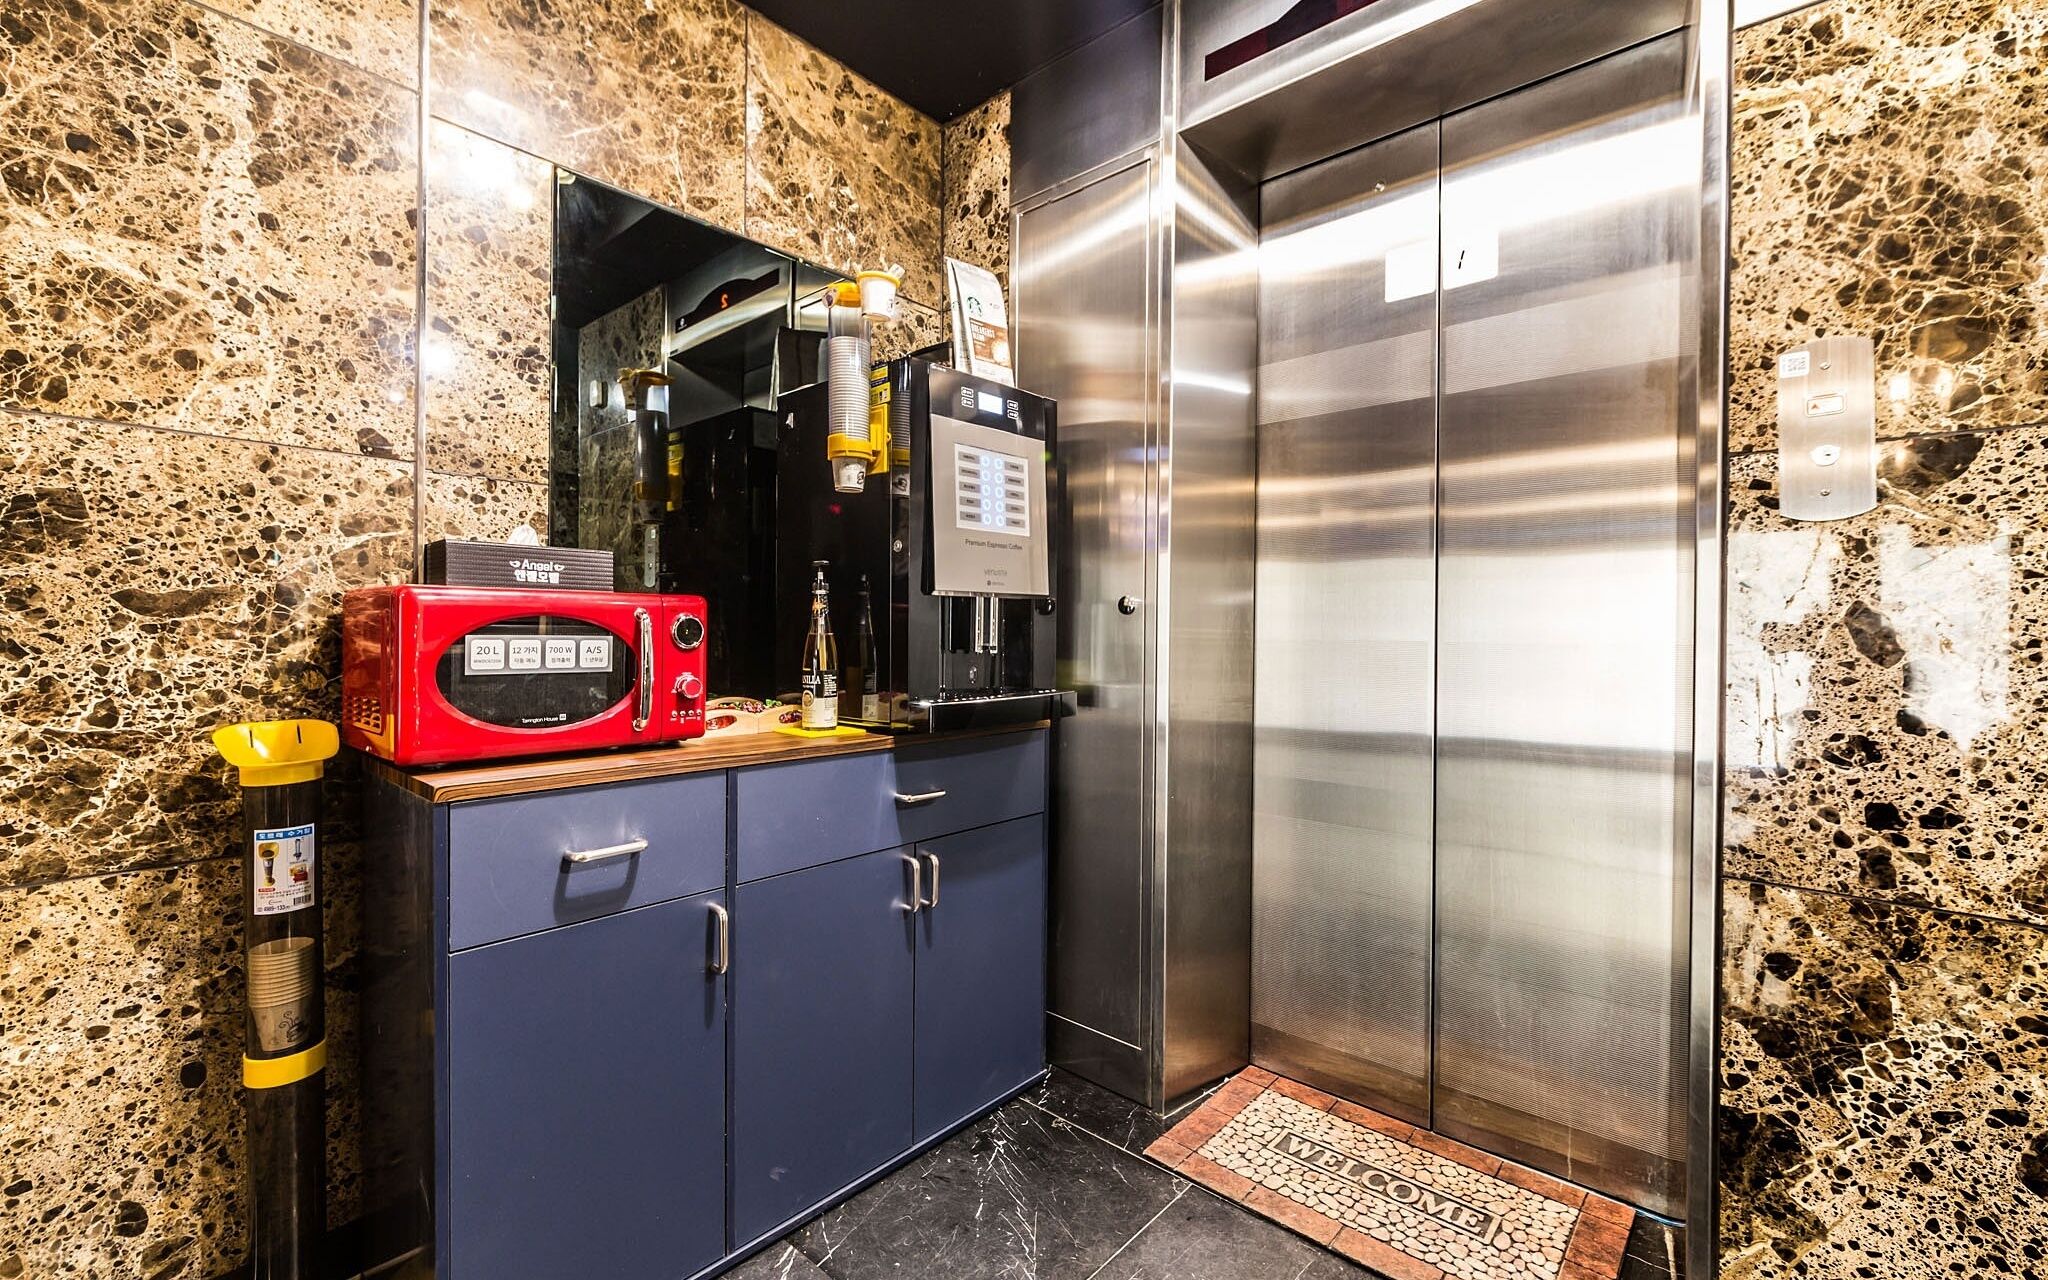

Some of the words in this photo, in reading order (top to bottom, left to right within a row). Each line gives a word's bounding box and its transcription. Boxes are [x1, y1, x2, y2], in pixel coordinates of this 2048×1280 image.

[521, 559, 553, 571] Angel
[476, 646, 490, 655] 20
[493, 646, 499, 655] L
[523, 646, 538, 654] 가지
[548, 646, 563, 654] 700
[565, 646, 573, 654] W
[586, 646, 602, 654] A/S
[1284, 1135, 1485, 1233] WELCOME
